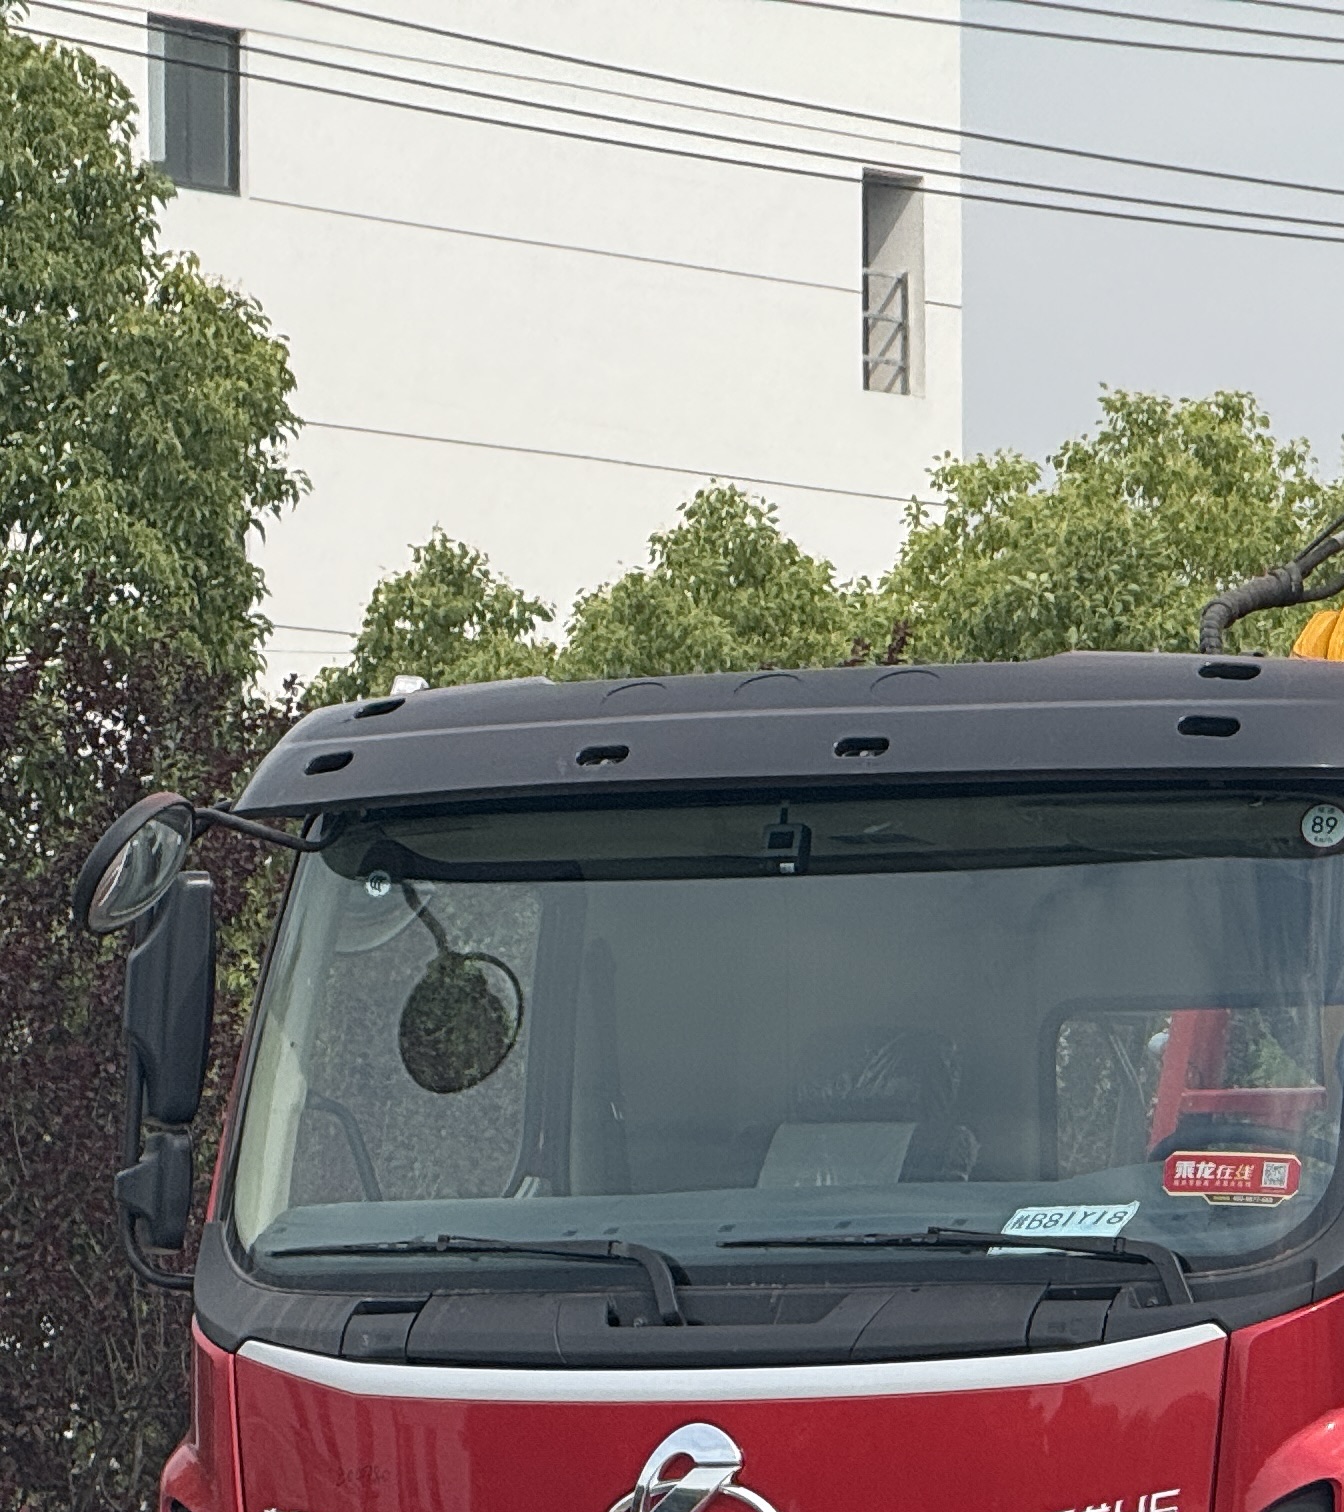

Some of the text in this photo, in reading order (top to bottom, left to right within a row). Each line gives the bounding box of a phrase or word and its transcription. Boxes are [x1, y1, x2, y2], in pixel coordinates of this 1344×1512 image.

[1311, 816, 1338, 834] 89
[1173, 1160, 1255, 1181] 乘龙在线
